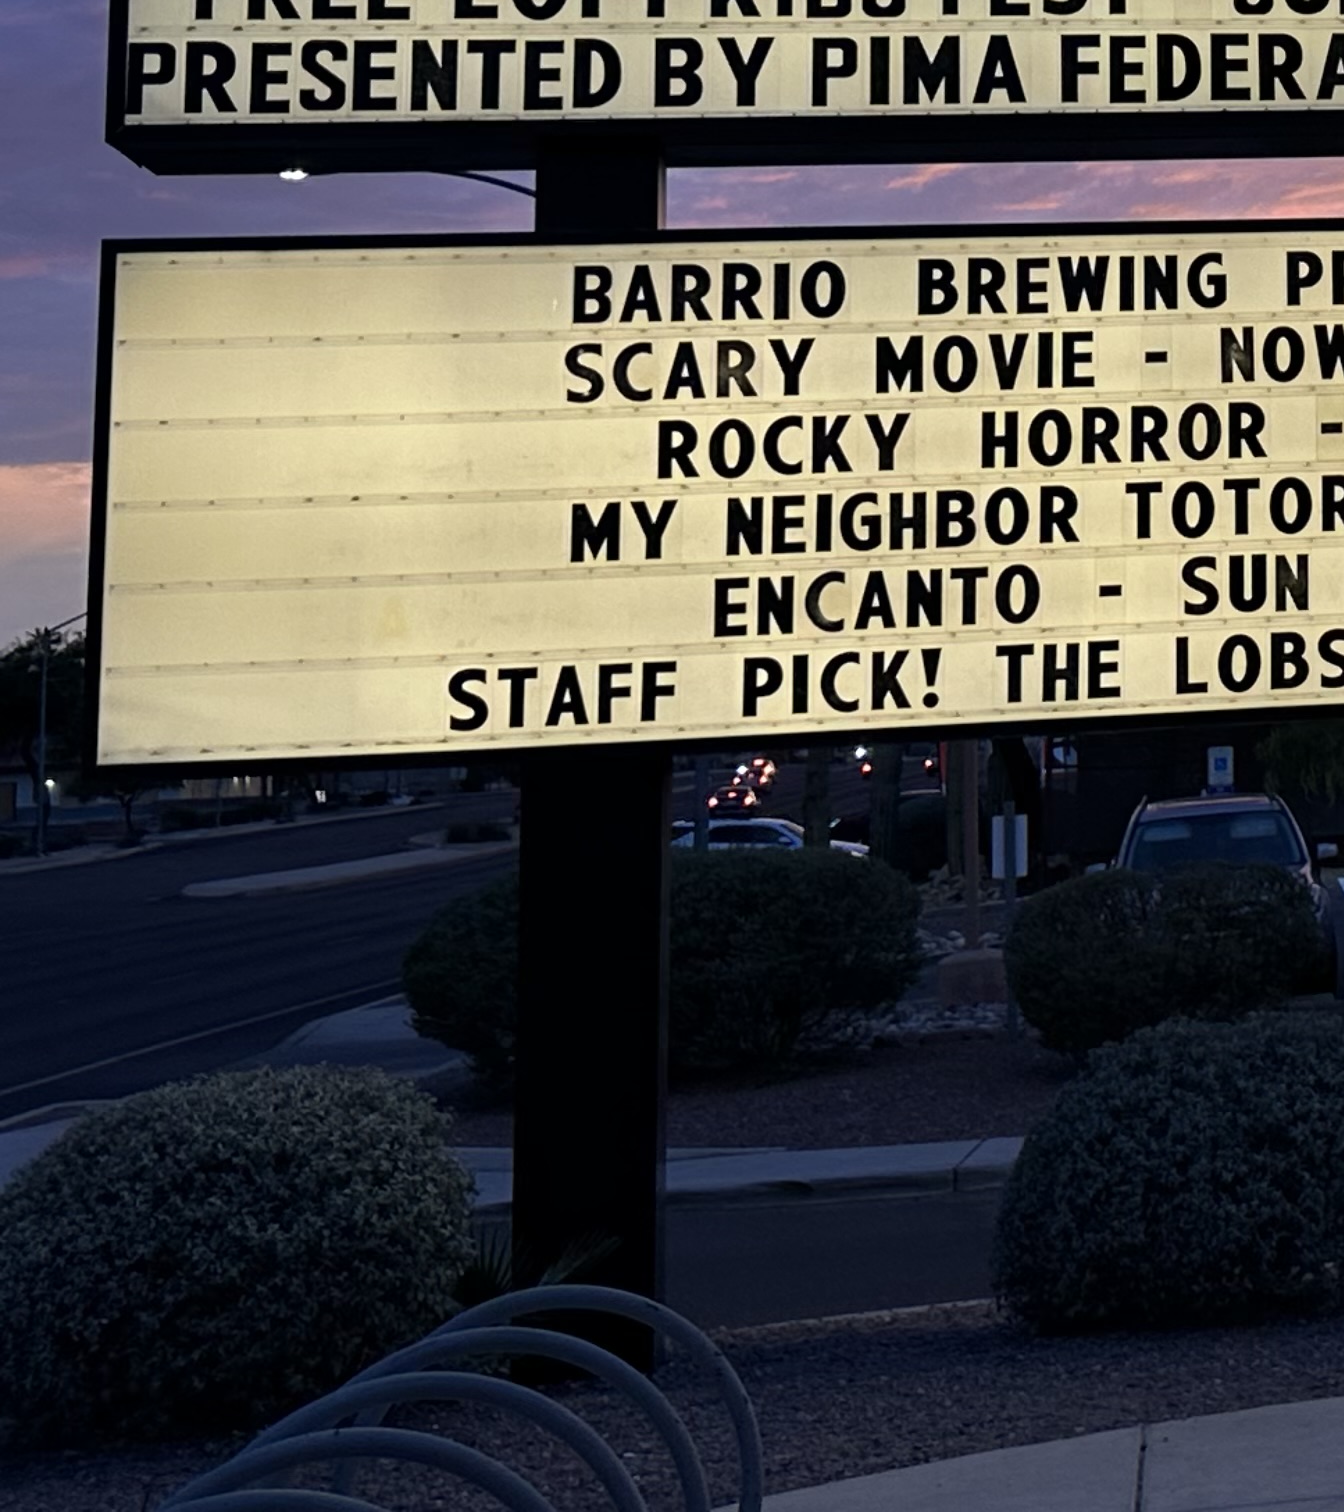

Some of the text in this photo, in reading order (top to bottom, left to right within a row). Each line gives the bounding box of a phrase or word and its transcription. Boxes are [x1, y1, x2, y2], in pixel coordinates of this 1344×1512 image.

[125, 39, 621, 117] PRESENTED
[654, 37, 774, 107] BY
[812, 35, 1026, 106] PIMA
[573, 261, 845, 323] BARRIO
[918, 253, 1226, 315] BREWING
[565, 338, 814, 403] SCARY
[877, 331, 1094, 393] MOVIE
[658, 413, 910, 478] ROCKY
[982, 402, 1267, 468] HORROR
[571, 500, 677, 562] MY
[727, 486, 1079, 555] NEIGHBOR
[714, 565, 1039, 637] ENCANTO
[1182, 554, 1308, 615] SUN
[449, 661, 676, 731] STAFF
[743, 648, 941, 717] PICK!
[996, 640, 1120, 702] THE
